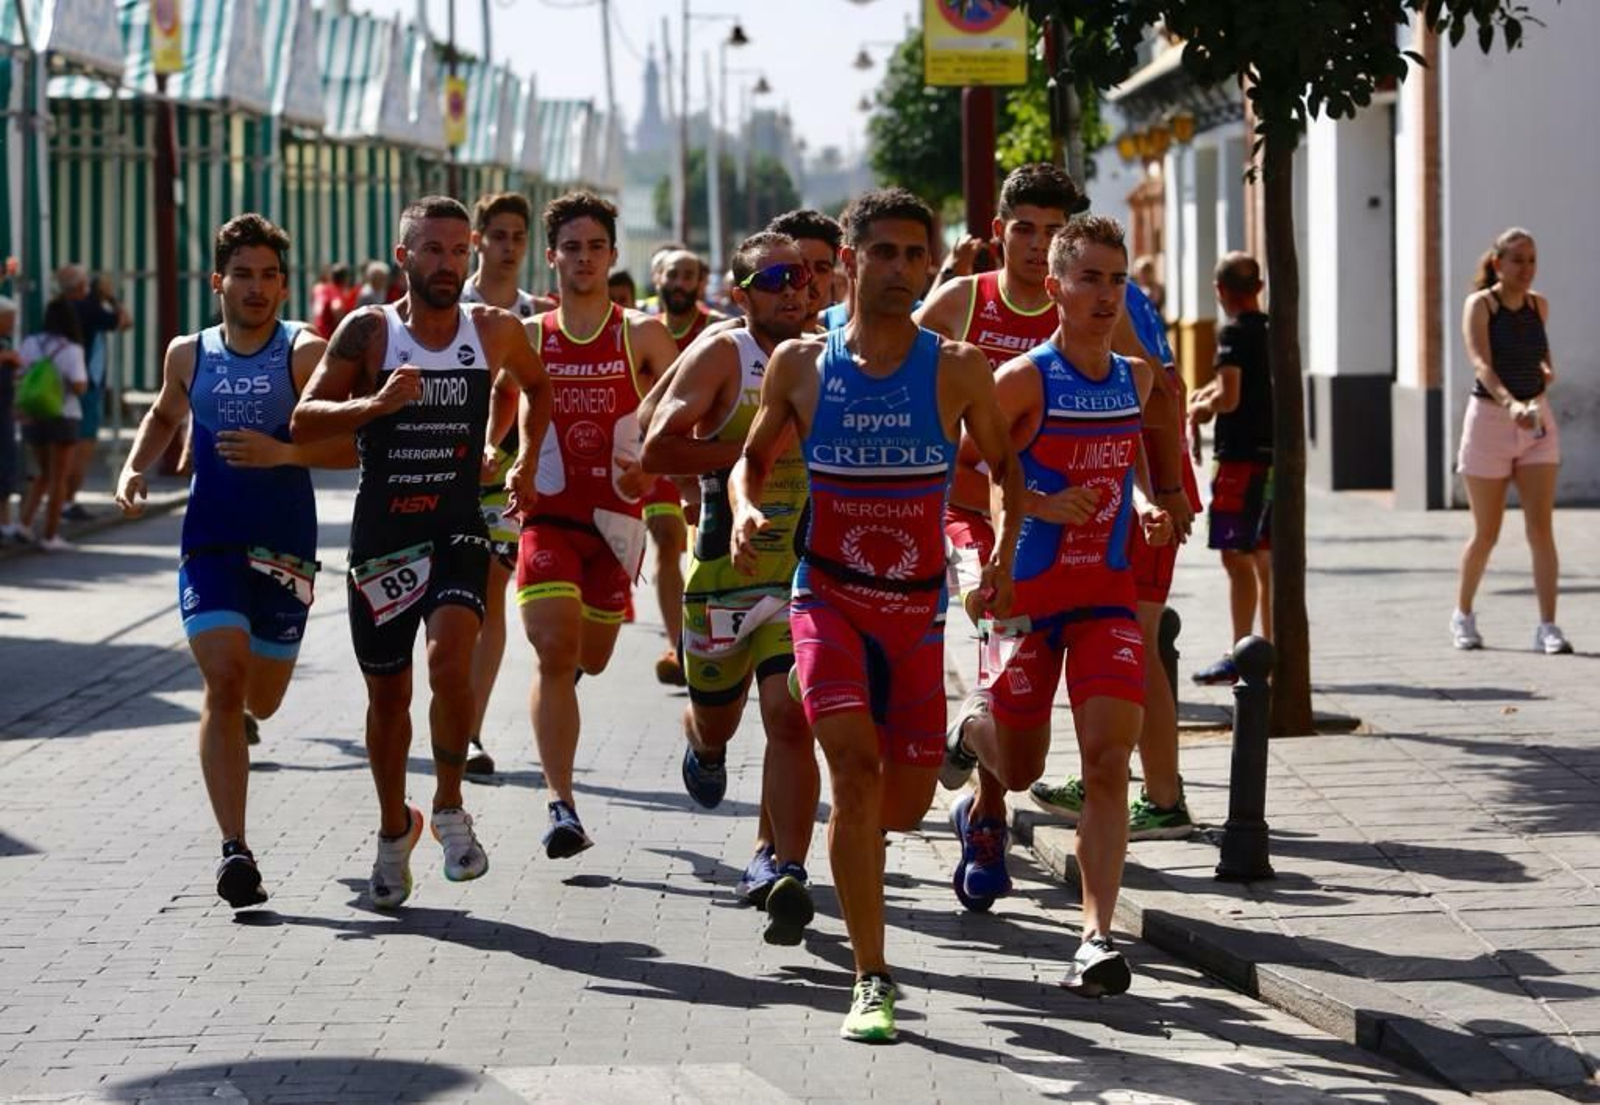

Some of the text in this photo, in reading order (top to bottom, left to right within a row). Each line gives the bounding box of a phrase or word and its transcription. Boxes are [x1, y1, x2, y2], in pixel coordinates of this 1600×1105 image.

[211, 375, 271, 394] ADS
[553, 386, 616, 413] HORNERO
[1057, 391, 1135, 410] CREDUS
[217, 400, 264, 424] HERCE
[842, 411, 911, 432] apyou
[388, 448, 454, 460] LASERGRAN
[812, 444, 944, 465] CREDUS
[387, 472, 457, 483] FASTER
[388, 494, 440, 513] HSN
[381, 568, 418, 600] 89
